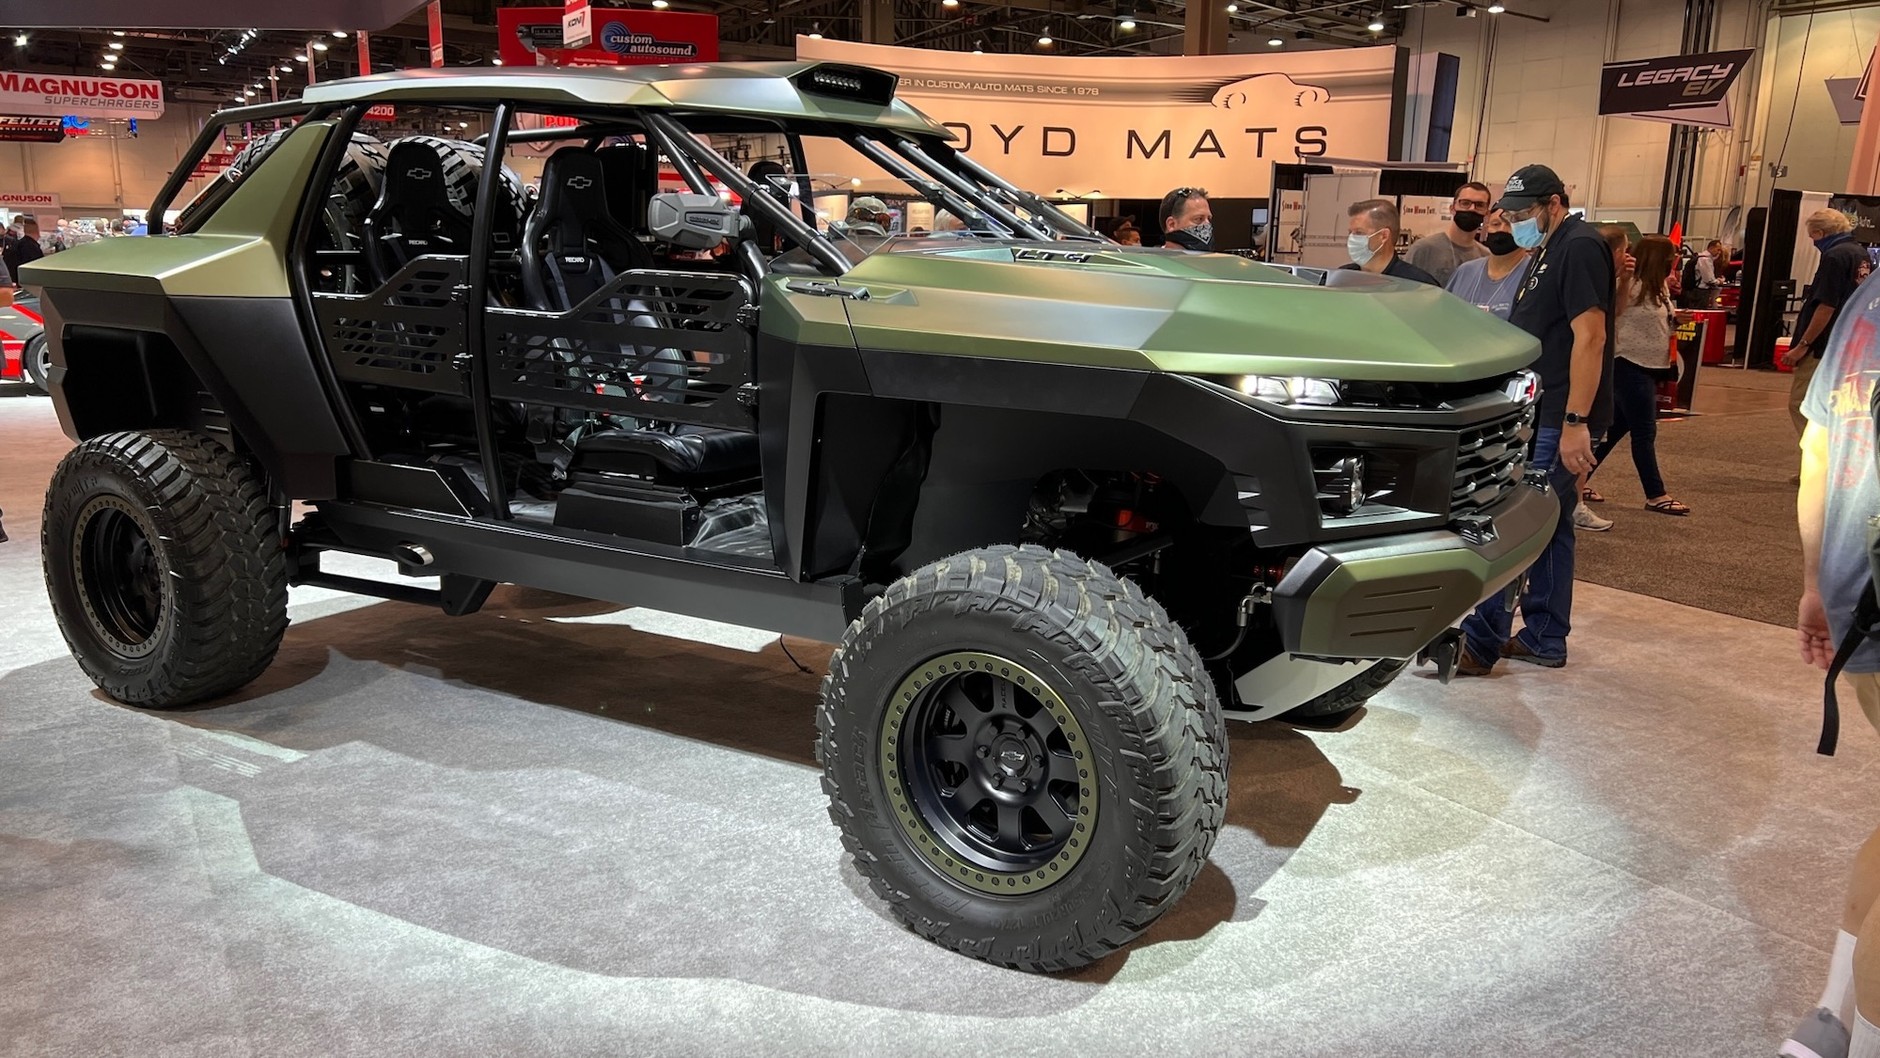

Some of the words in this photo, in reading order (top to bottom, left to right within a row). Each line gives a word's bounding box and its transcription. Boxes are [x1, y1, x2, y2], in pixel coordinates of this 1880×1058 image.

[610, 34, 653, 44] custom
[630, 44, 692, 56] autosound
[1617, 63, 1735, 88] LEGACY
[0, 74, 159, 99] MAGNUSON
[926, 80, 971, 89] CUSTOM
[973, 83, 1001, 91] AUTO
[1005, 85, 1034, 93] MATS
[1037, 86, 1067, 94] SINCE
[1072, 87, 1099, 96] 1978
[1682, 79, 1725, 97] EV
[44, 95, 159, 109] SUPERCHARGERS
[1126, 125, 1328, 159] MATS
